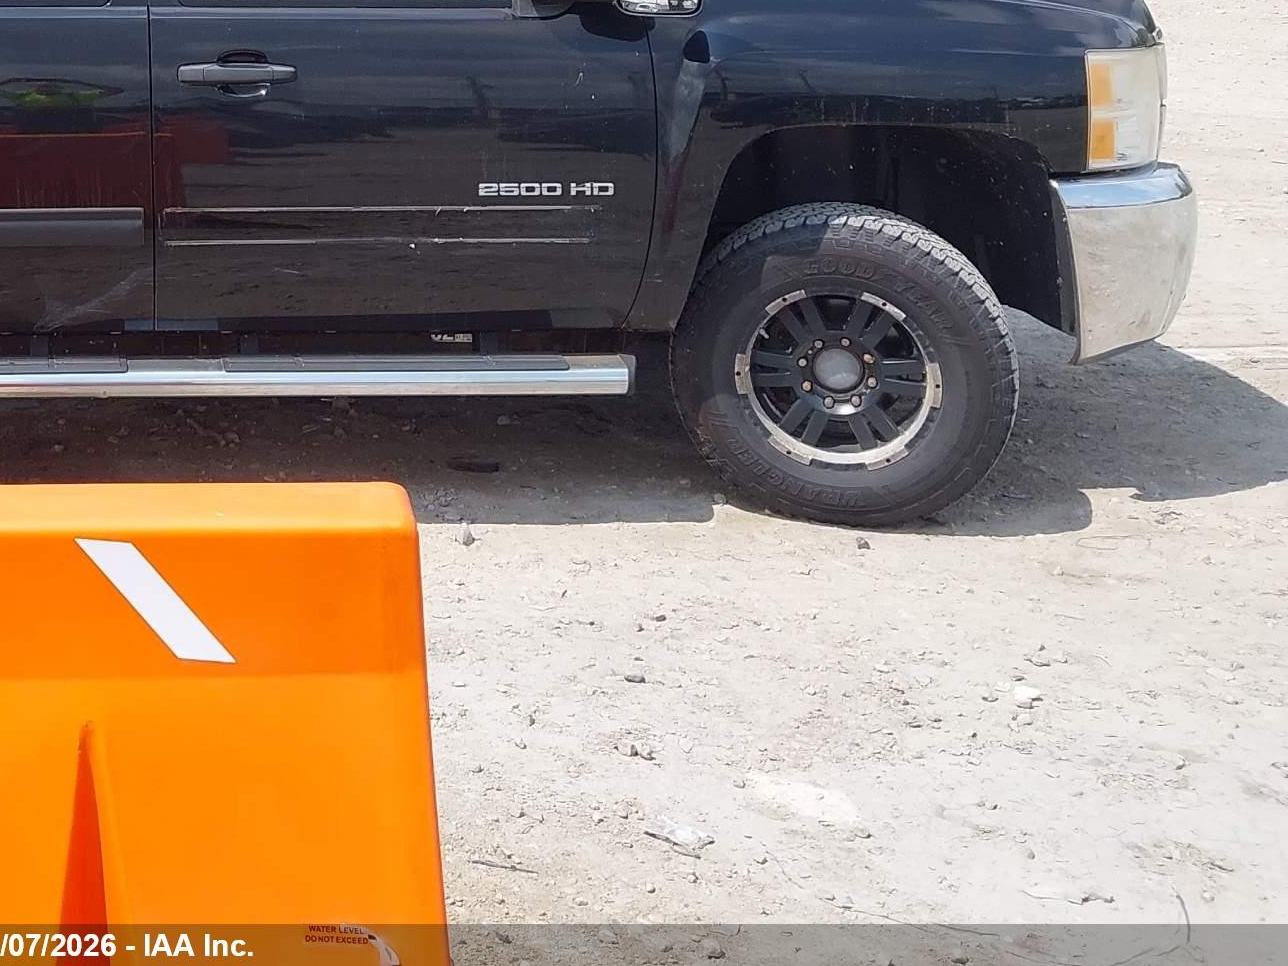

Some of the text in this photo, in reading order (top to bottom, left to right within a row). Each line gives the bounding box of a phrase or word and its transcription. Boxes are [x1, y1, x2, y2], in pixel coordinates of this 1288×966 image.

[478, 183, 615, 196] 2500 HD
[308, 925, 366, 935] WATER LEVEL
[305, 935, 317, 943] DO
[335, 936, 369, 945] EXCEED
